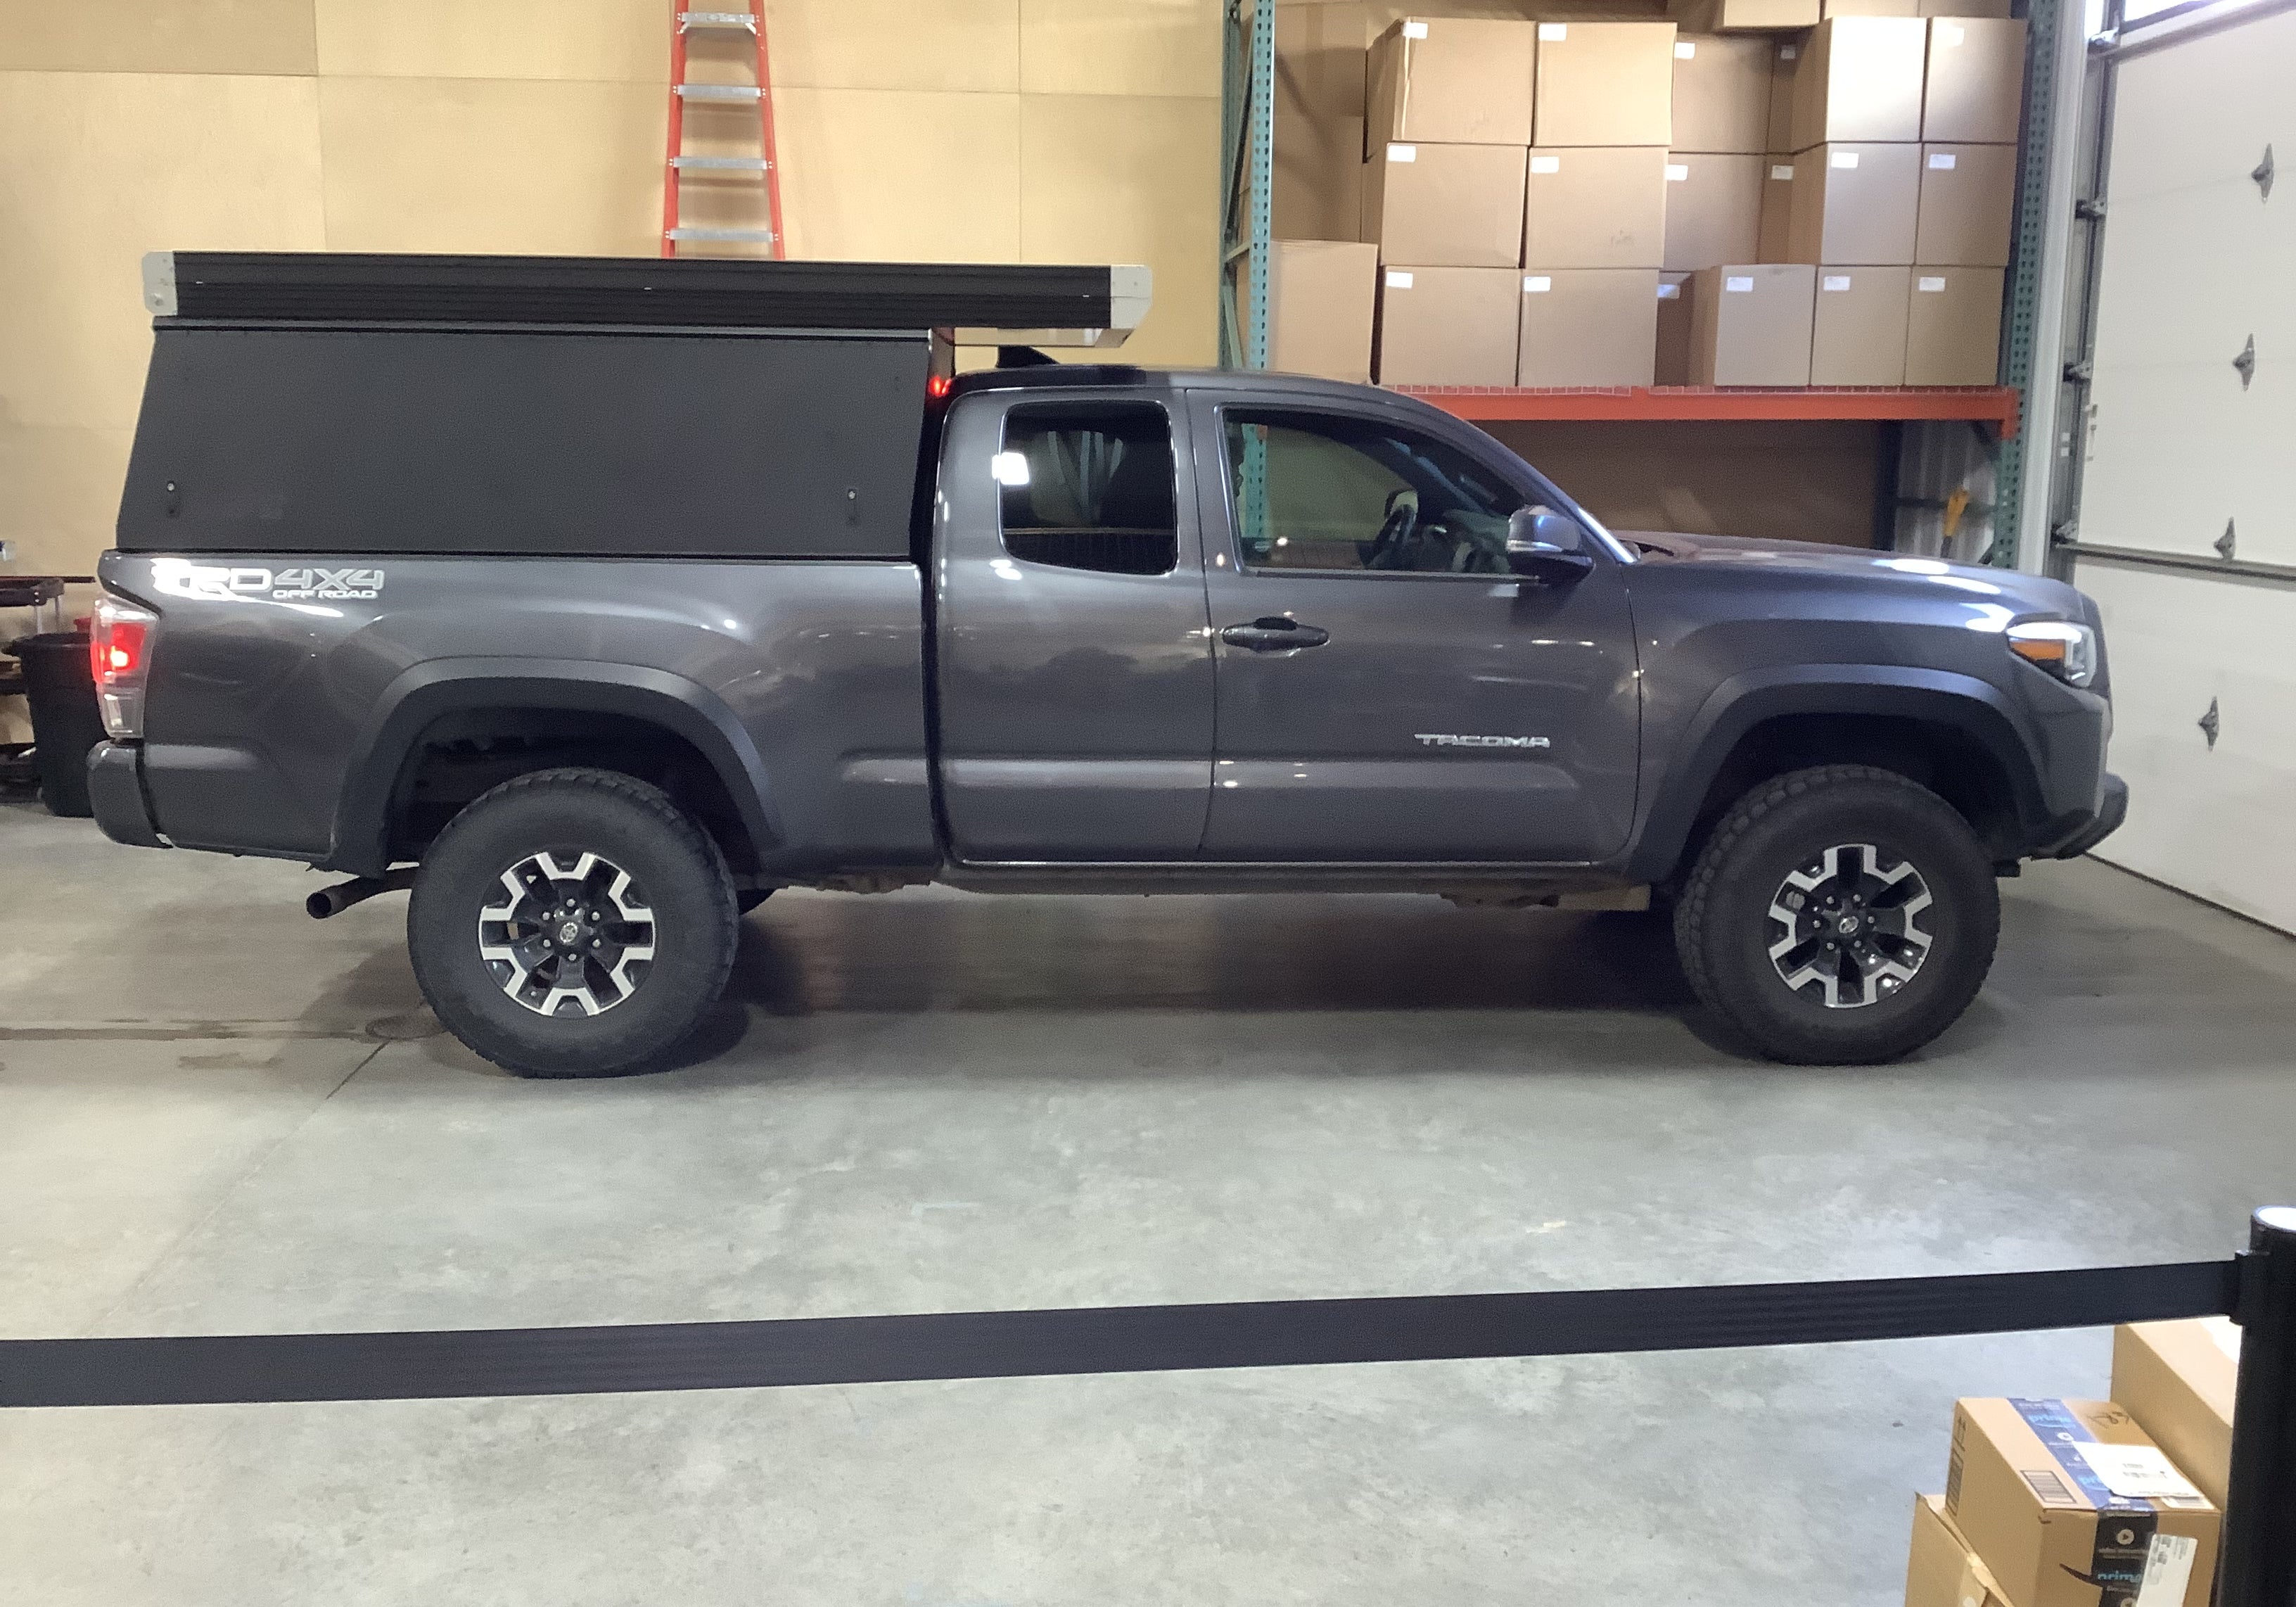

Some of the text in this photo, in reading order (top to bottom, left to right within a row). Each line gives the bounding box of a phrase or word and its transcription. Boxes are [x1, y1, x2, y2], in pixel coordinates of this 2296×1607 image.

[274, 568, 385, 590] 4X4
[272, 589, 378, 599] OFF ROAD
[1414, 734, 1550, 748] TACOMA
